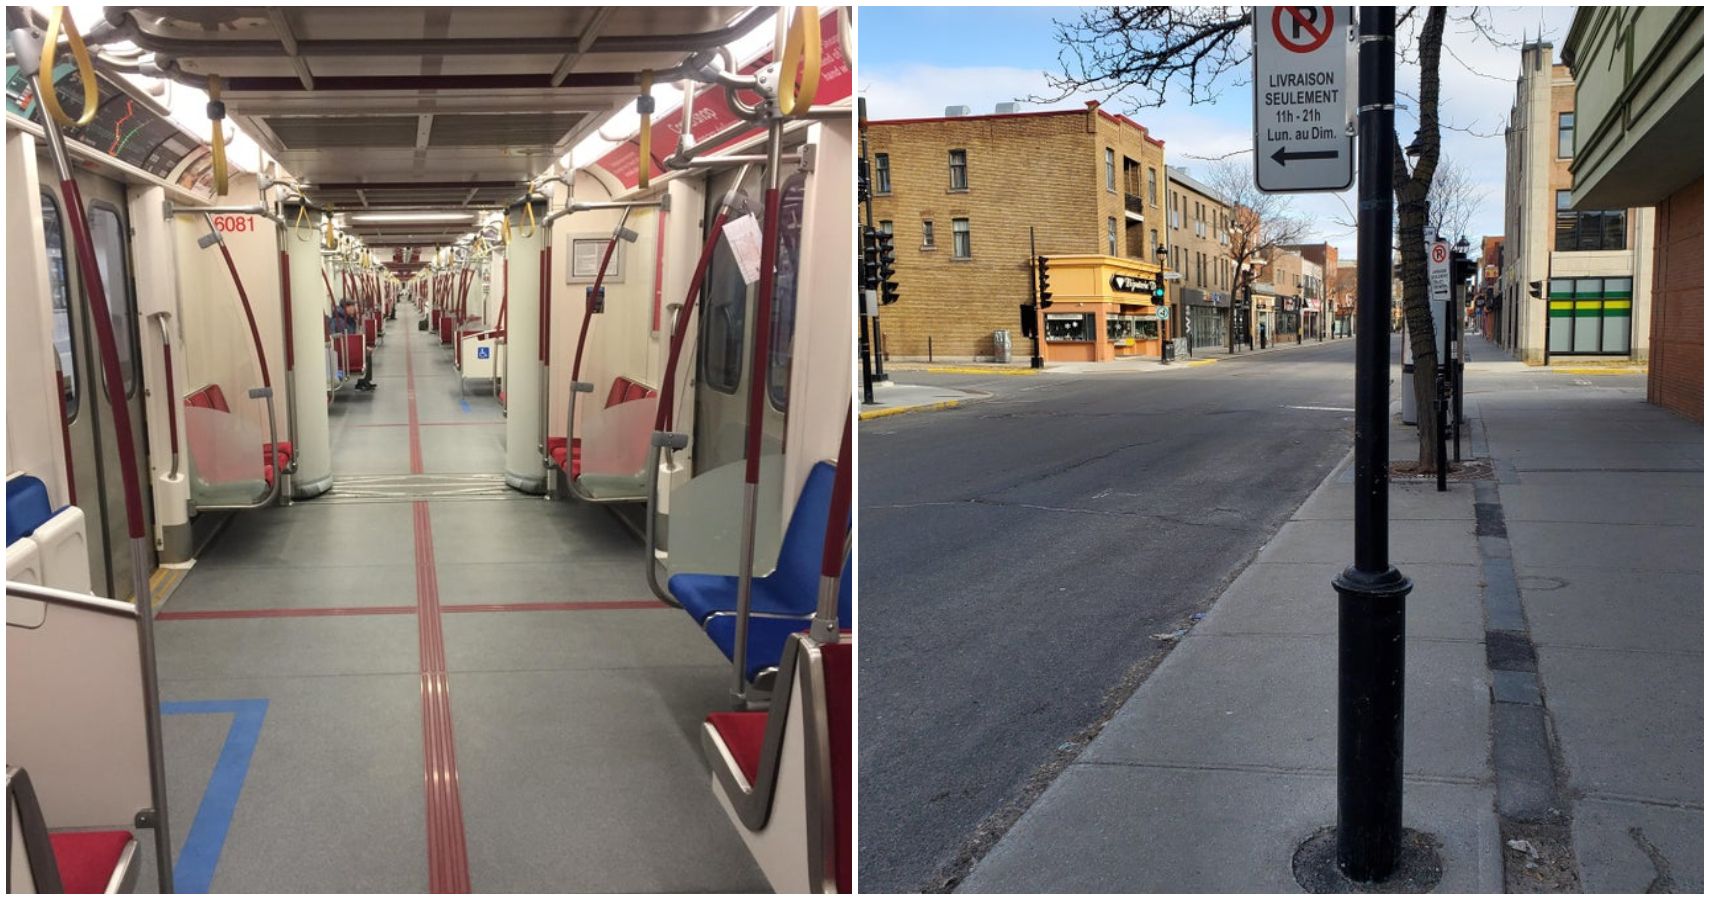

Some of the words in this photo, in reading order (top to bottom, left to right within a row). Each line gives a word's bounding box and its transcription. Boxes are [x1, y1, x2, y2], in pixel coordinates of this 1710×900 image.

[1269, 72, 1334, 88] LIVRAISON
[1265, 89, 1339, 106] SEULEMENT
[1275, 110, 1293, 123] 11h
[1302, 108, 1321, 122] 21h
[1267, 128, 1292, 141] Lun.
[1295, 130, 1309, 141] au
[1311, 126, 1337, 140] Dim.
[214, 215, 255, 232] 6081
